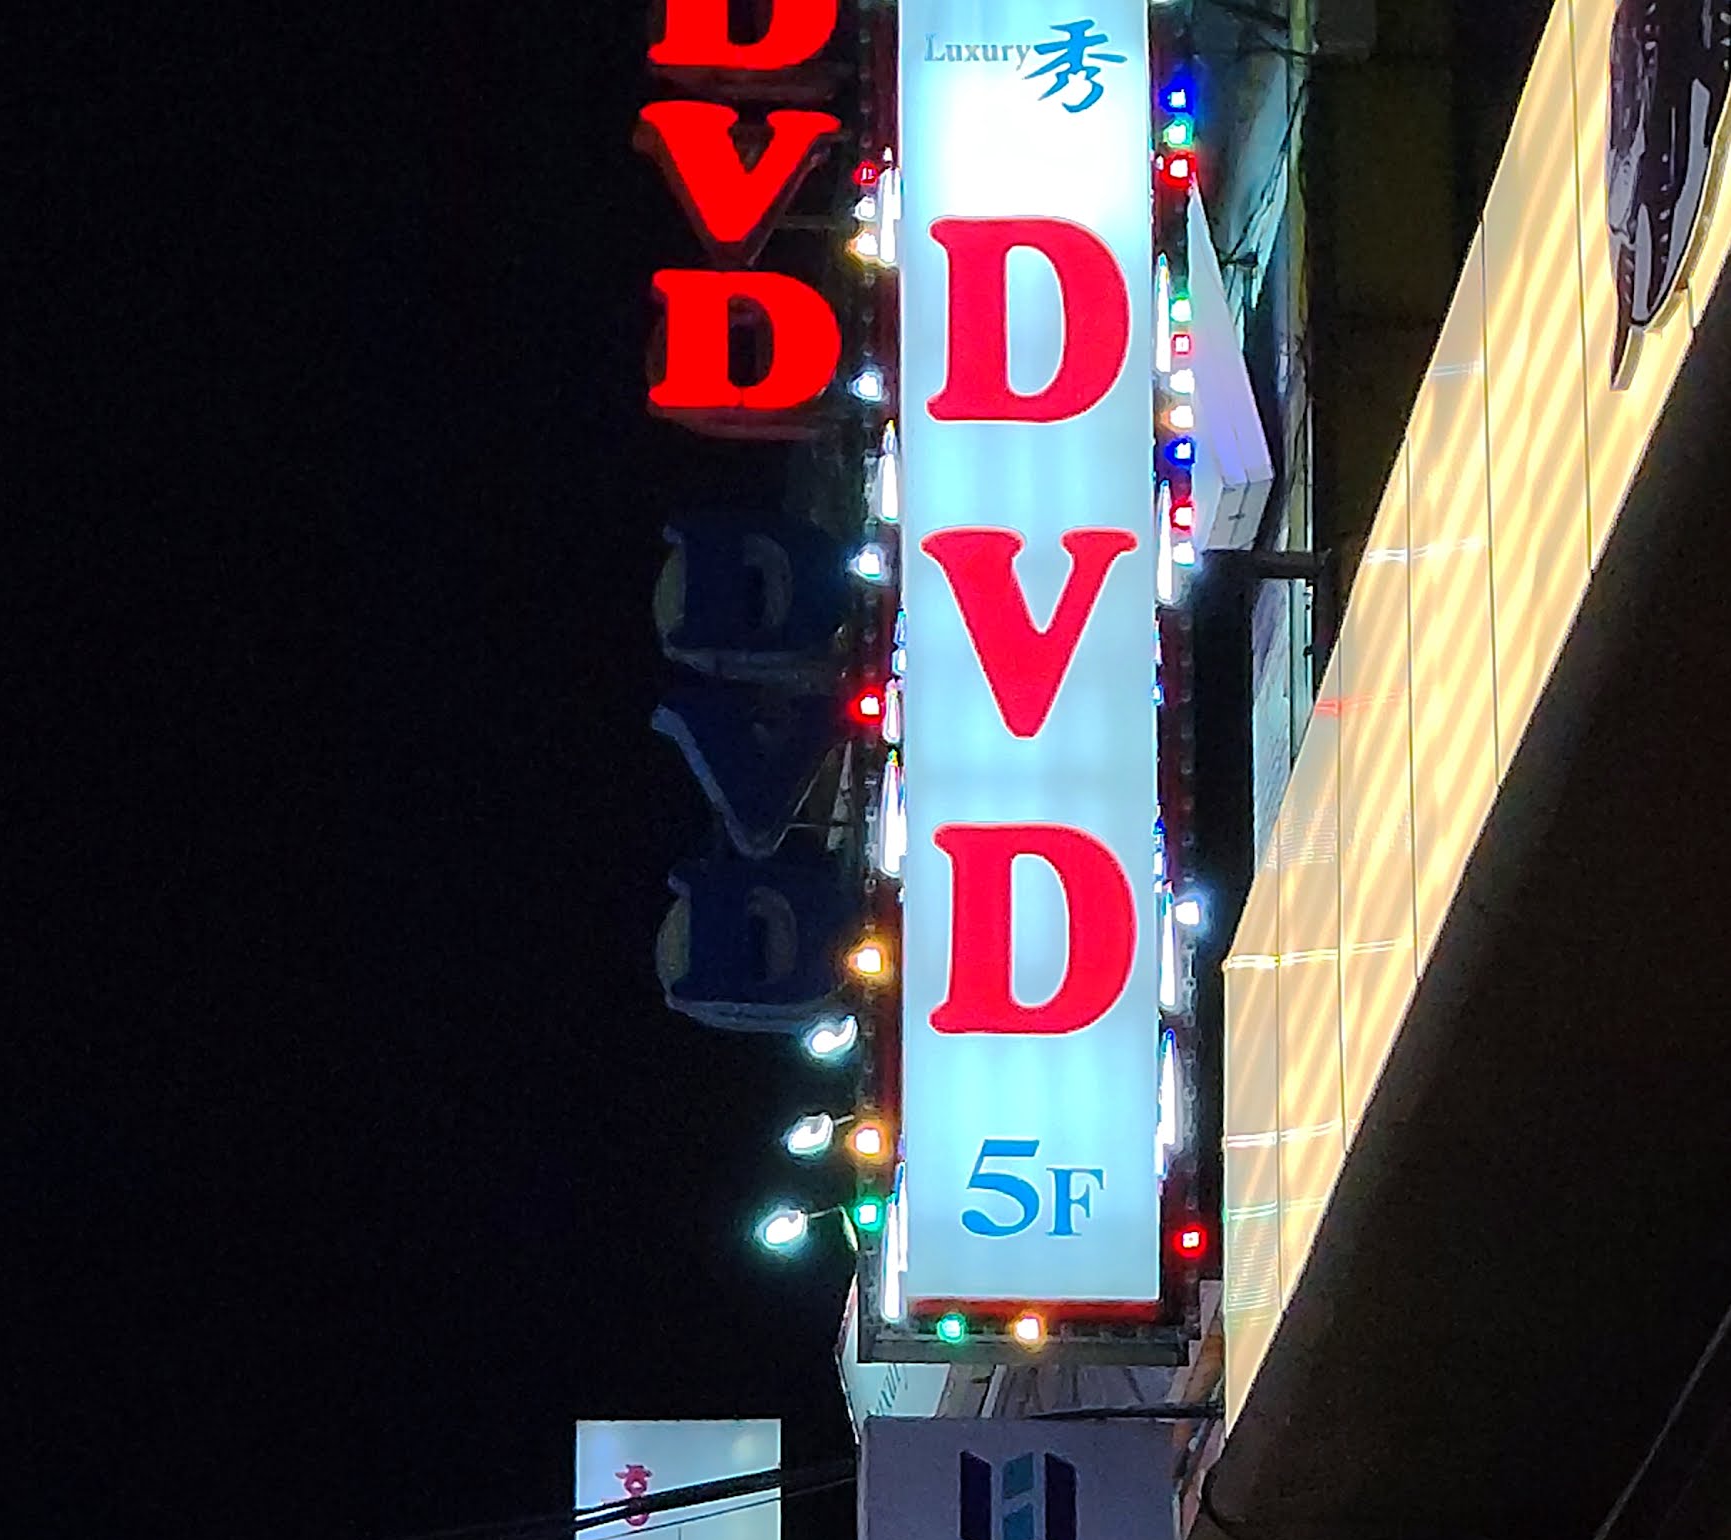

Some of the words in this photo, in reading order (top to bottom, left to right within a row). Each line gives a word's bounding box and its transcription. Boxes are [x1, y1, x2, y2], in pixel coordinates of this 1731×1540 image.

[923, 33, 1031, 66] Luxury
[1022, 19, 1128, 113] 秀
[920, 215, 1139, 1037] DVD
[960, 1137, 1105, 1239] 5F
